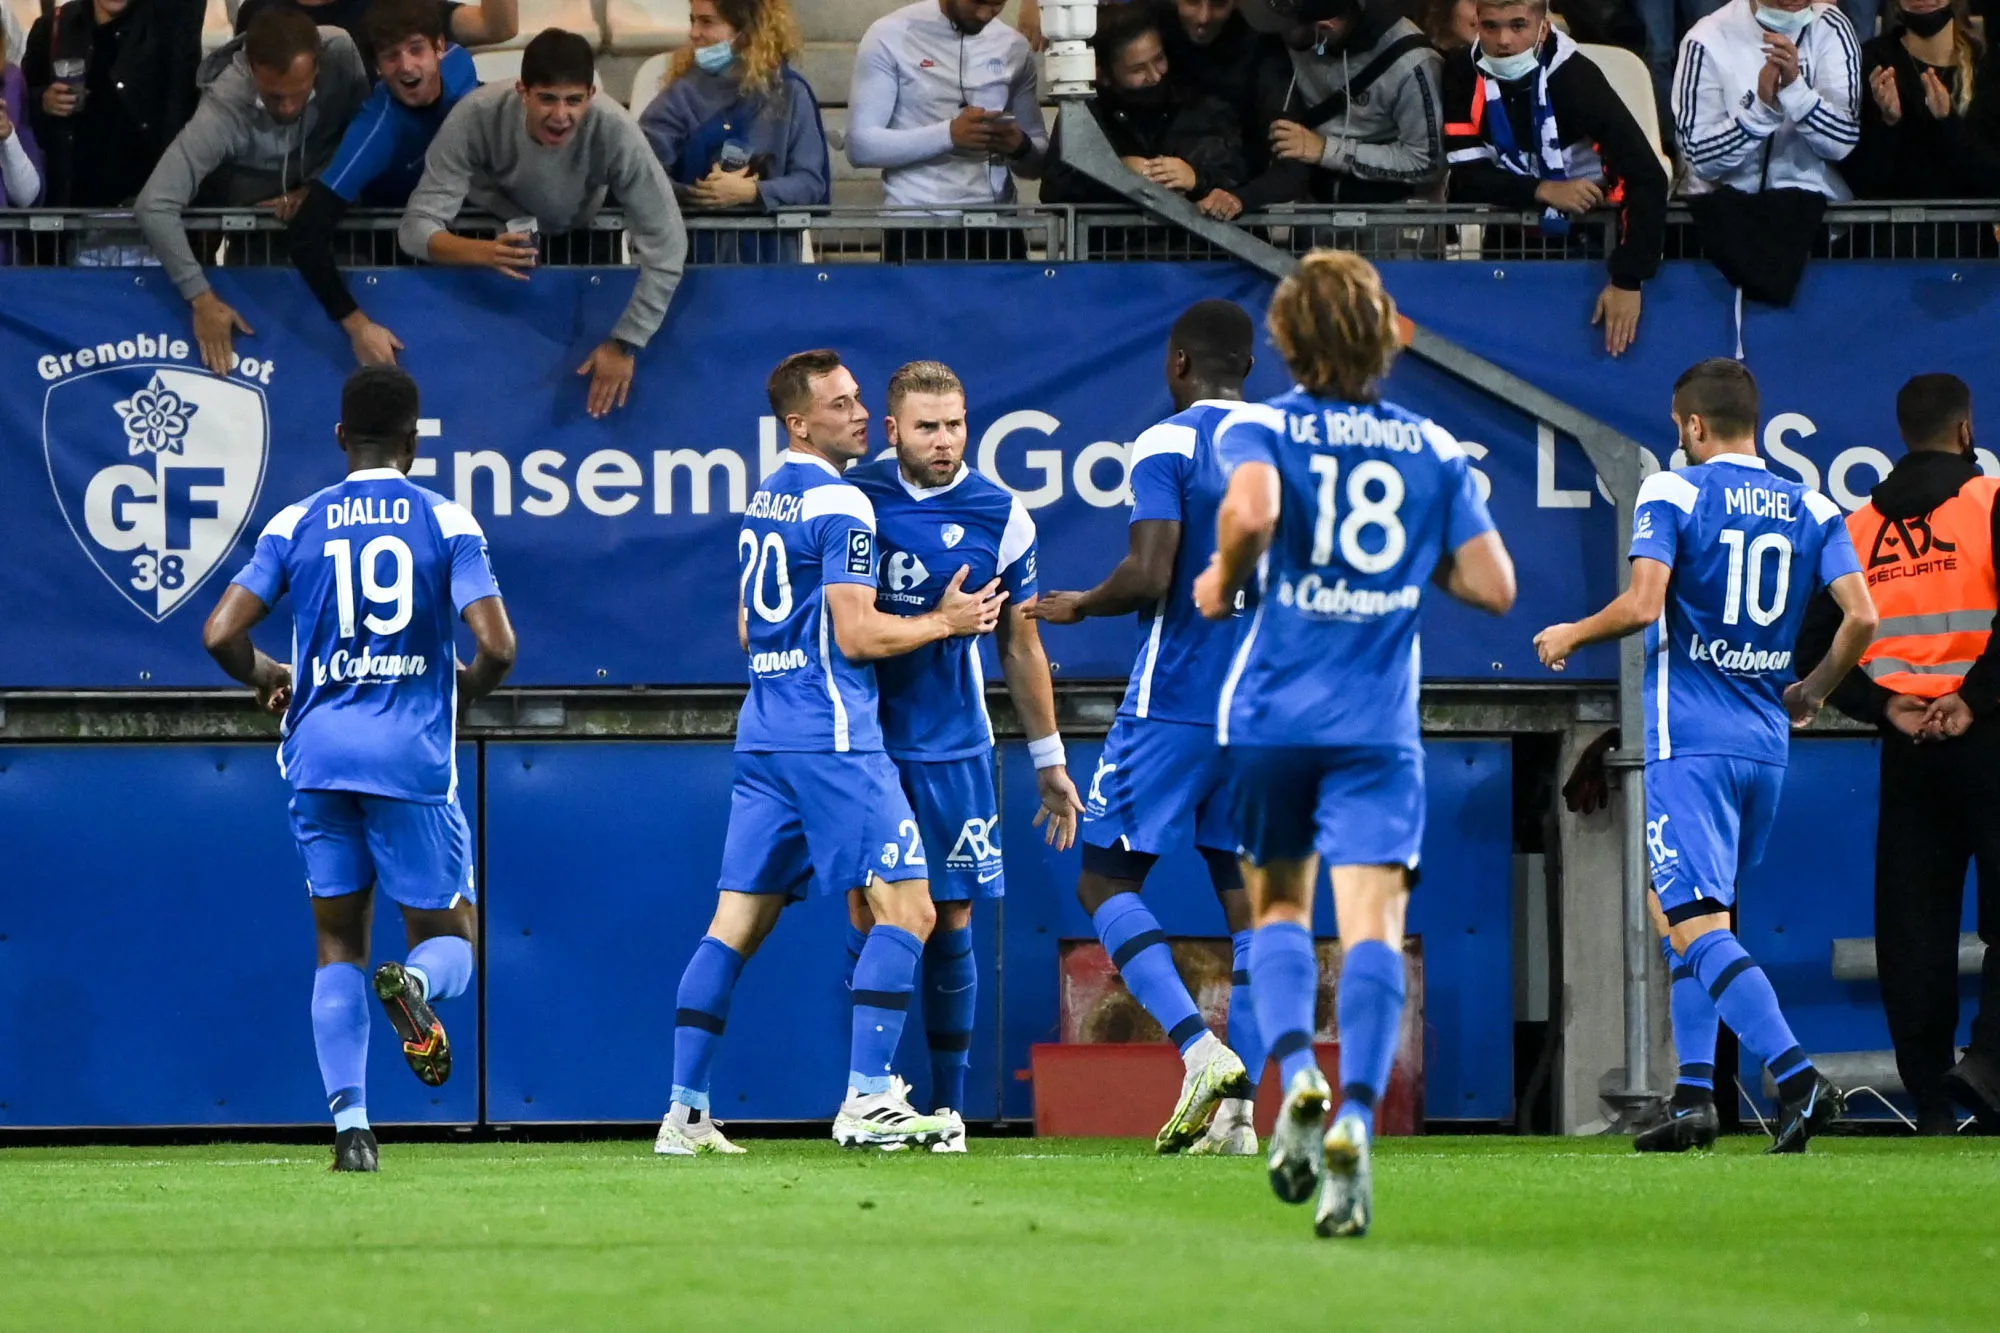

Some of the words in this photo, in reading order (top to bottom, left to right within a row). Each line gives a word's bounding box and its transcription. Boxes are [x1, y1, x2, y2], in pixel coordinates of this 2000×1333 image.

[37, 333, 189, 380] Grenoble
[231, 351, 275, 384] ot
[84, 464, 225, 551] GF
[1309, 453, 1406, 574] 18
[130, 554, 185, 591] 38
[323, 535, 413, 638] 19
[738, 528, 793, 623] 20
[879, 591, 925, 605] rrefour
[1719, 529, 1792, 627] 10
[330, 646, 427, 681] Cabanon
[753, 649, 808, 673] anon
[946, 814, 1002, 861] ABC
[1647, 814, 1678, 867] BC
